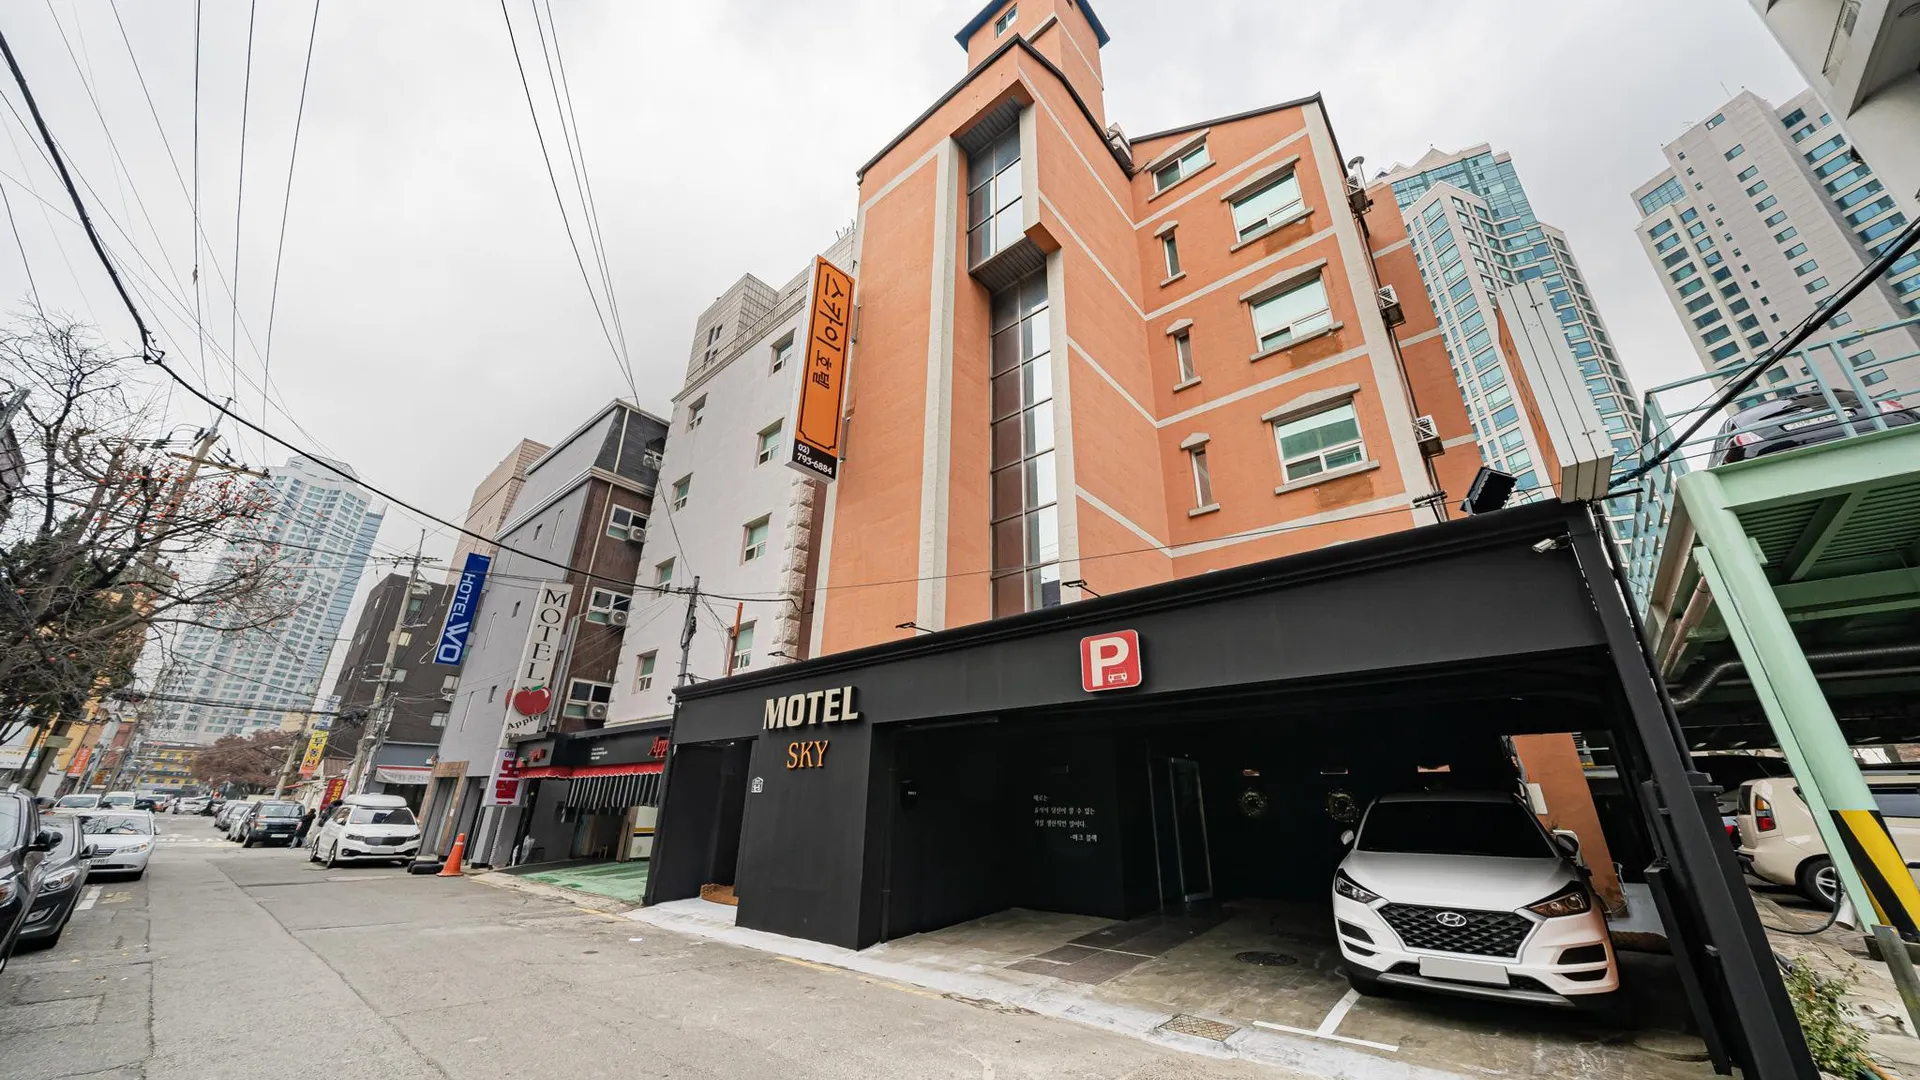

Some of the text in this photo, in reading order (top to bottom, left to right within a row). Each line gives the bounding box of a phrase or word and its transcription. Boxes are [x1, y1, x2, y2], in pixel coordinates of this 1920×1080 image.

[812, 273, 844, 390] 스카이 호텔
[796, 452, 833, 475] 793-6884
[797, 443, 811, 455] 02)
[449, 572, 477, 622] HOTEL
[526, 588, 568, 681] MOTEL
[1090, 636, 1129, 688] P
[506, 715, 540, 731] Apple
[762, 685, 859, 730] MOTEL
[786, 739, 829, 769] SKY
